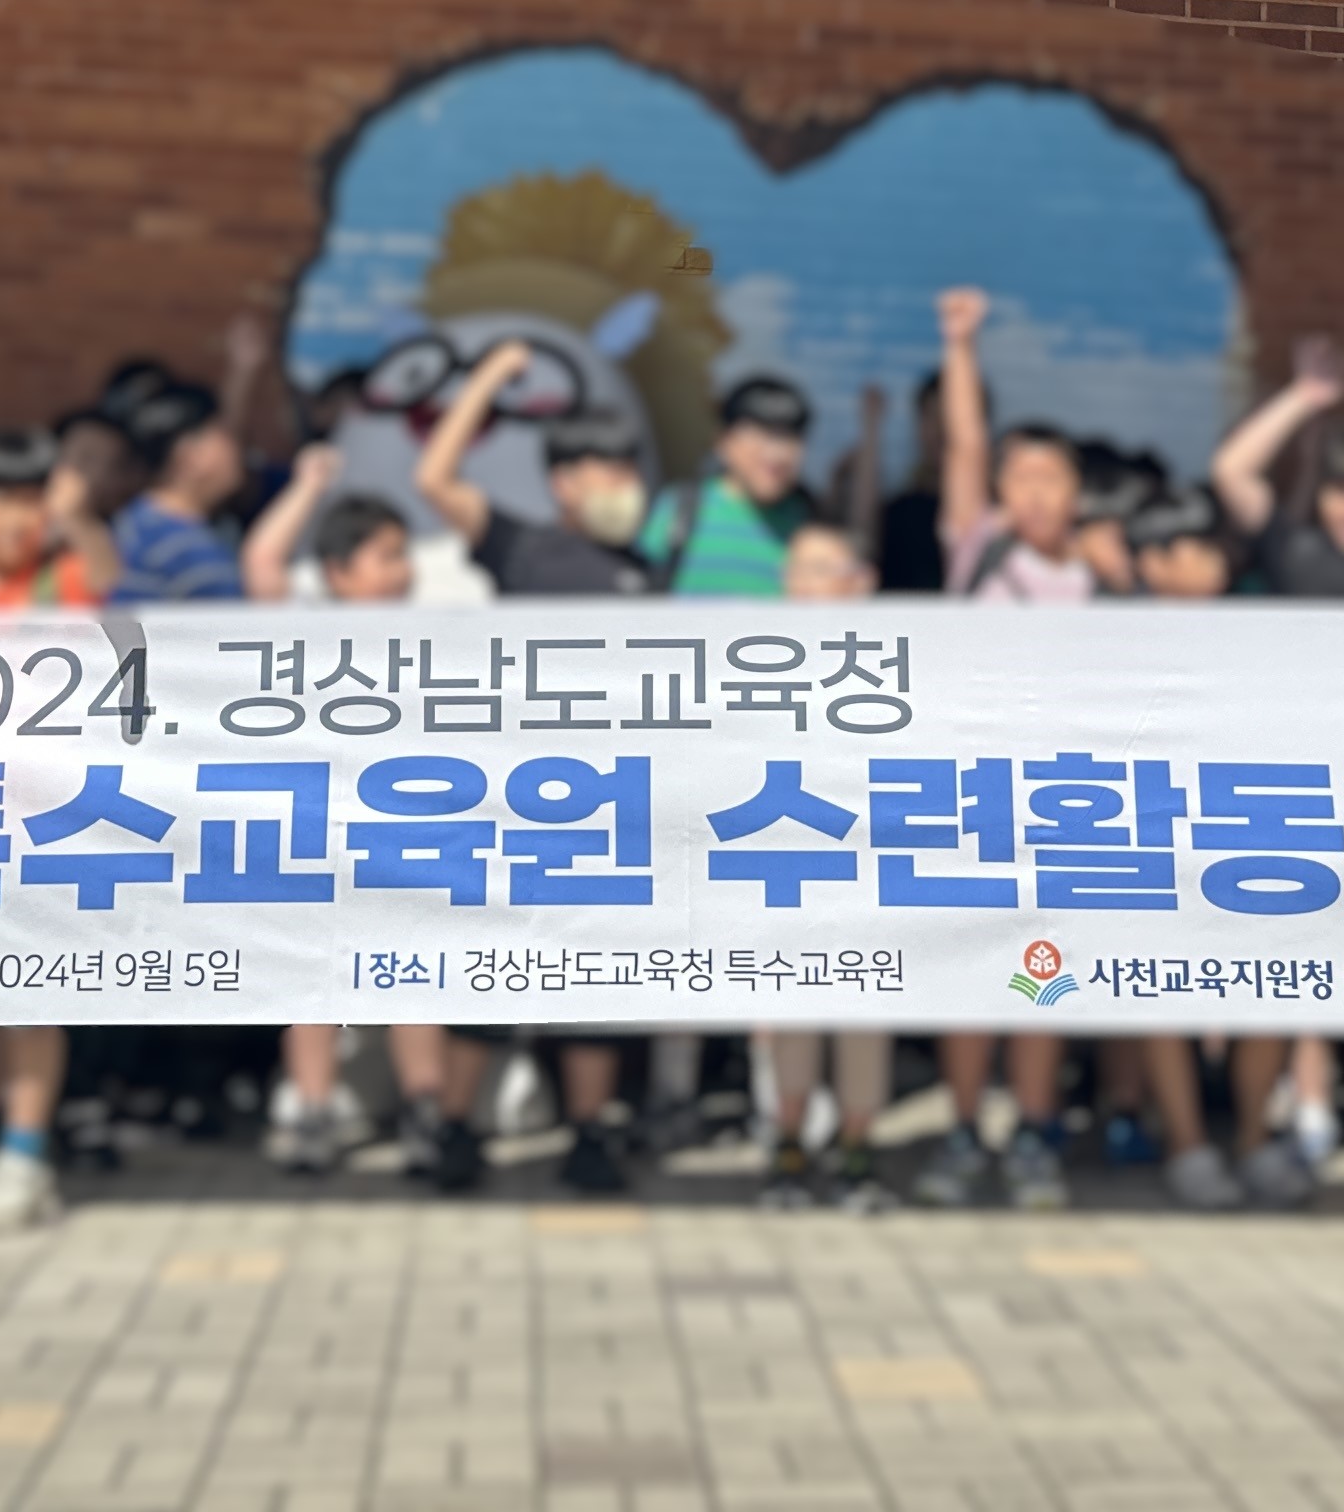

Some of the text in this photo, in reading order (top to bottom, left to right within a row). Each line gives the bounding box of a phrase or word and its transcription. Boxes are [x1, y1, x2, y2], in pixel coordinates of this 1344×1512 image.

[218, 631, 913, 737] 경상남도교육청
[115, 949, 172, 992] 9월
[184, 949, 240, 992] 5일
[464, 948, 713, 992] 경상남도교육청
[724, 949, 904, 992] 특수교육원
[1088, 958, 1333, 1001] 사천교육지원청
